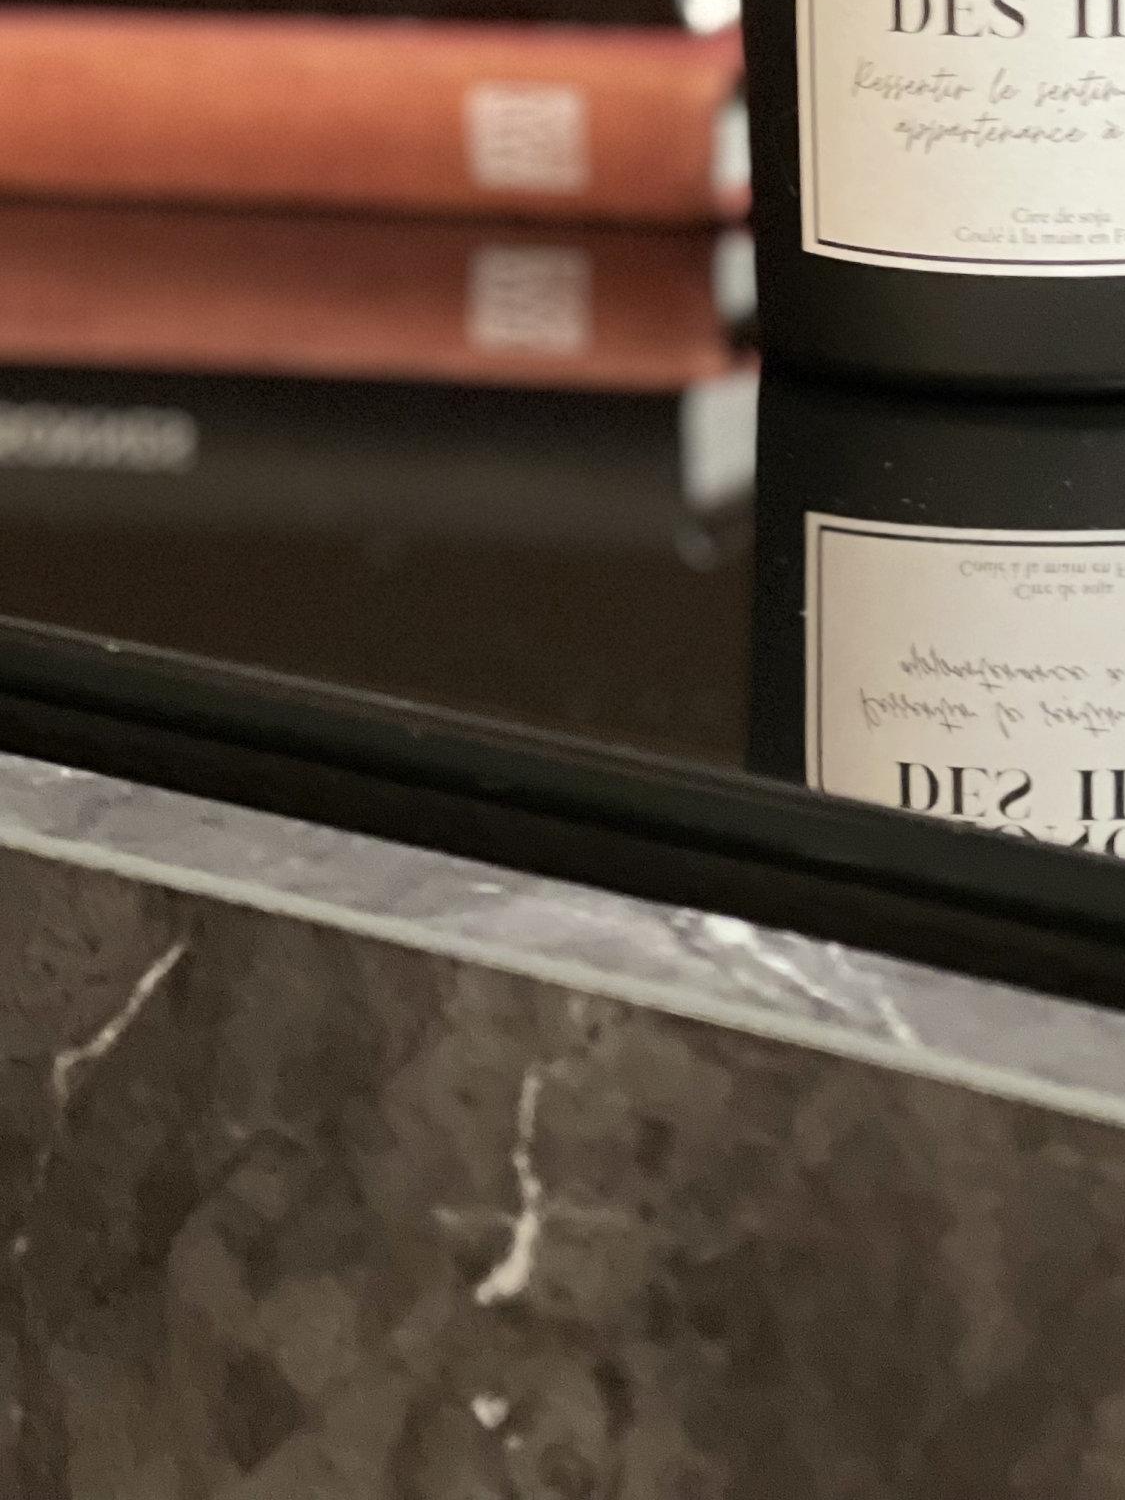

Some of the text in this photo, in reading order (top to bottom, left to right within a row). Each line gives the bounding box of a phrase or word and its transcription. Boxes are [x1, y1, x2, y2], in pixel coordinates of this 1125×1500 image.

[852, 60, 974, 102] Ressentir
[987, 67, 1021, 104] le
[893, 111, 1087, 154] appartenance
[1100, 118, 1125, 141] à
[1053, 206, 1075, 223] de
[1041, 230, 1085, 245] main
[1088, 233, 1111, 245] en
